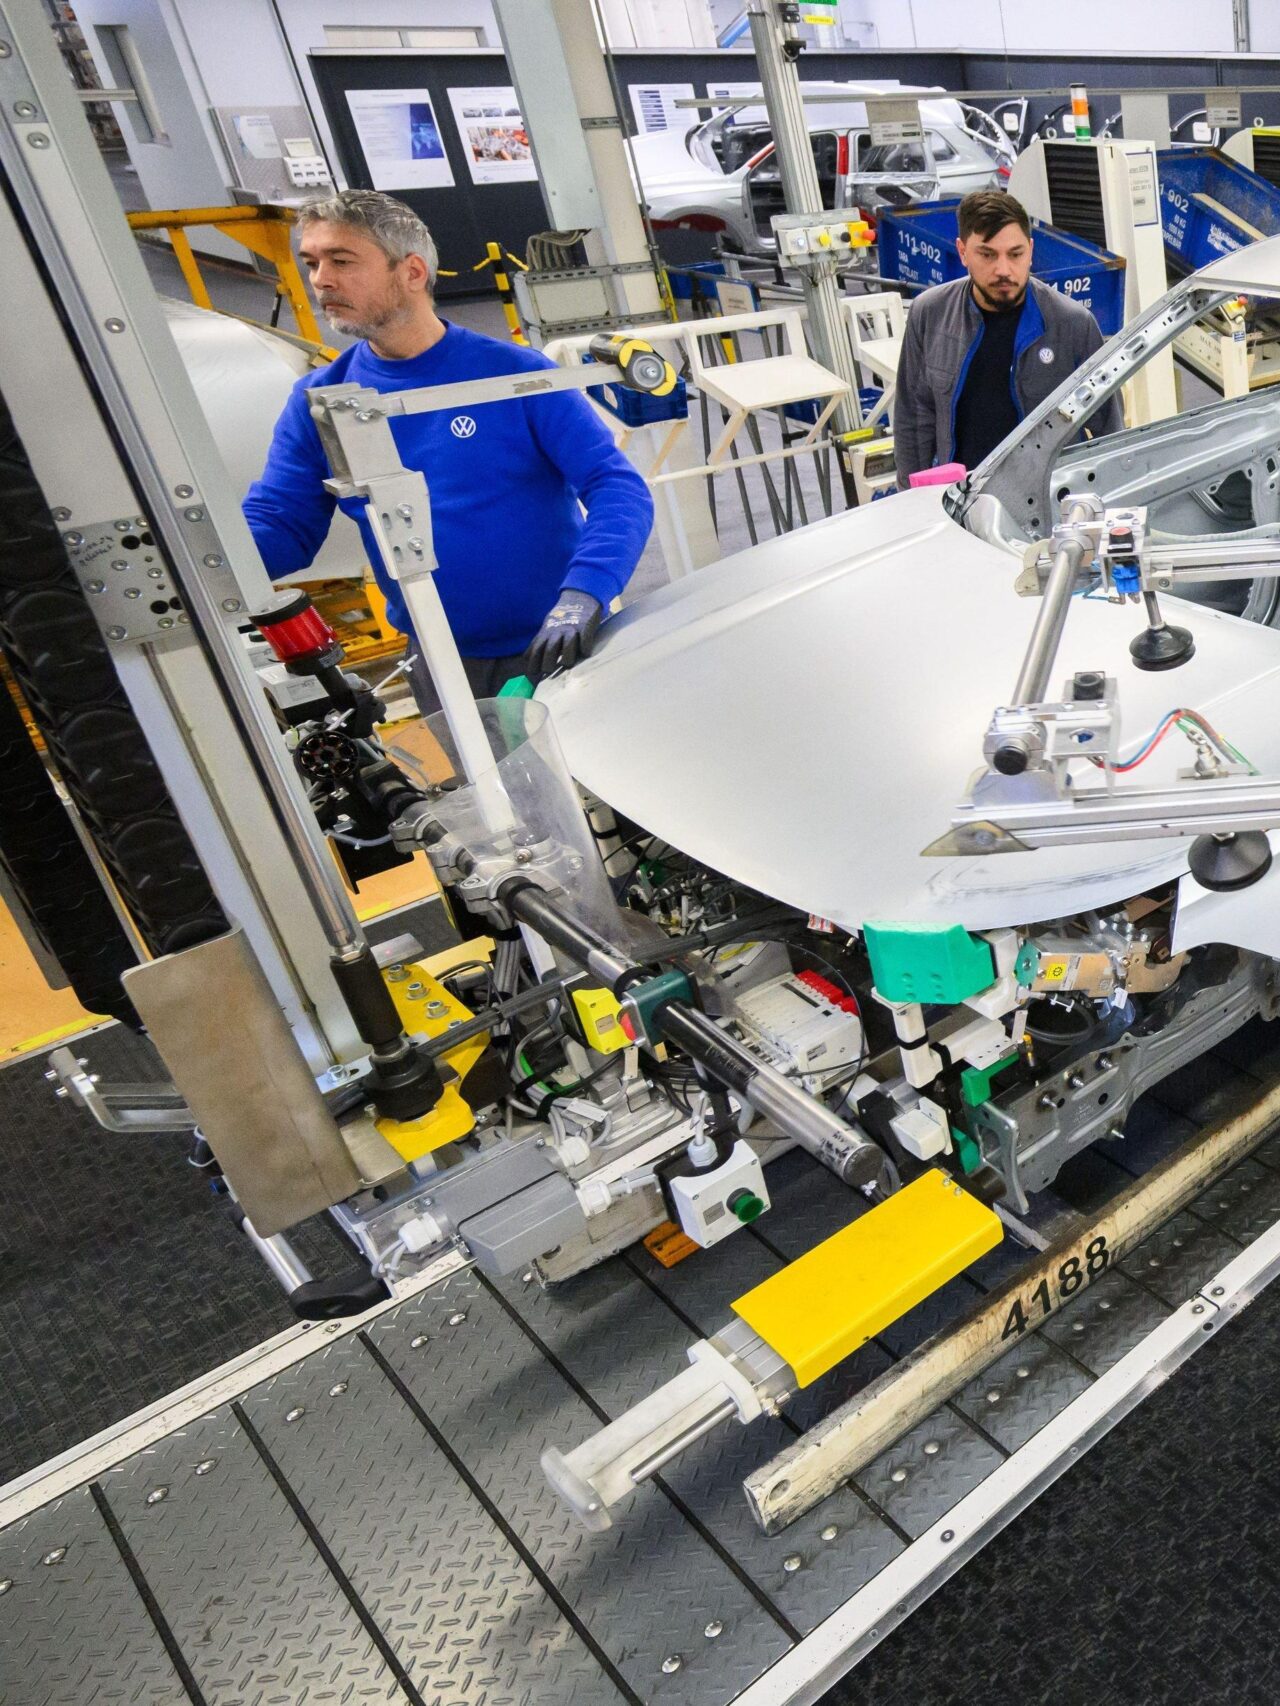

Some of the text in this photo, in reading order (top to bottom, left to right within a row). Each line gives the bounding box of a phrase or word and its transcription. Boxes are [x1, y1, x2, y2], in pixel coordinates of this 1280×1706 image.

[1167, 189, 1189, 213] 902
[920, 241, 941, 264] 902
[1064, 277, 1091, 297] 902
[451, 415, 476, 438] VW
[1001, 1236, 1109, 1340] 4188
